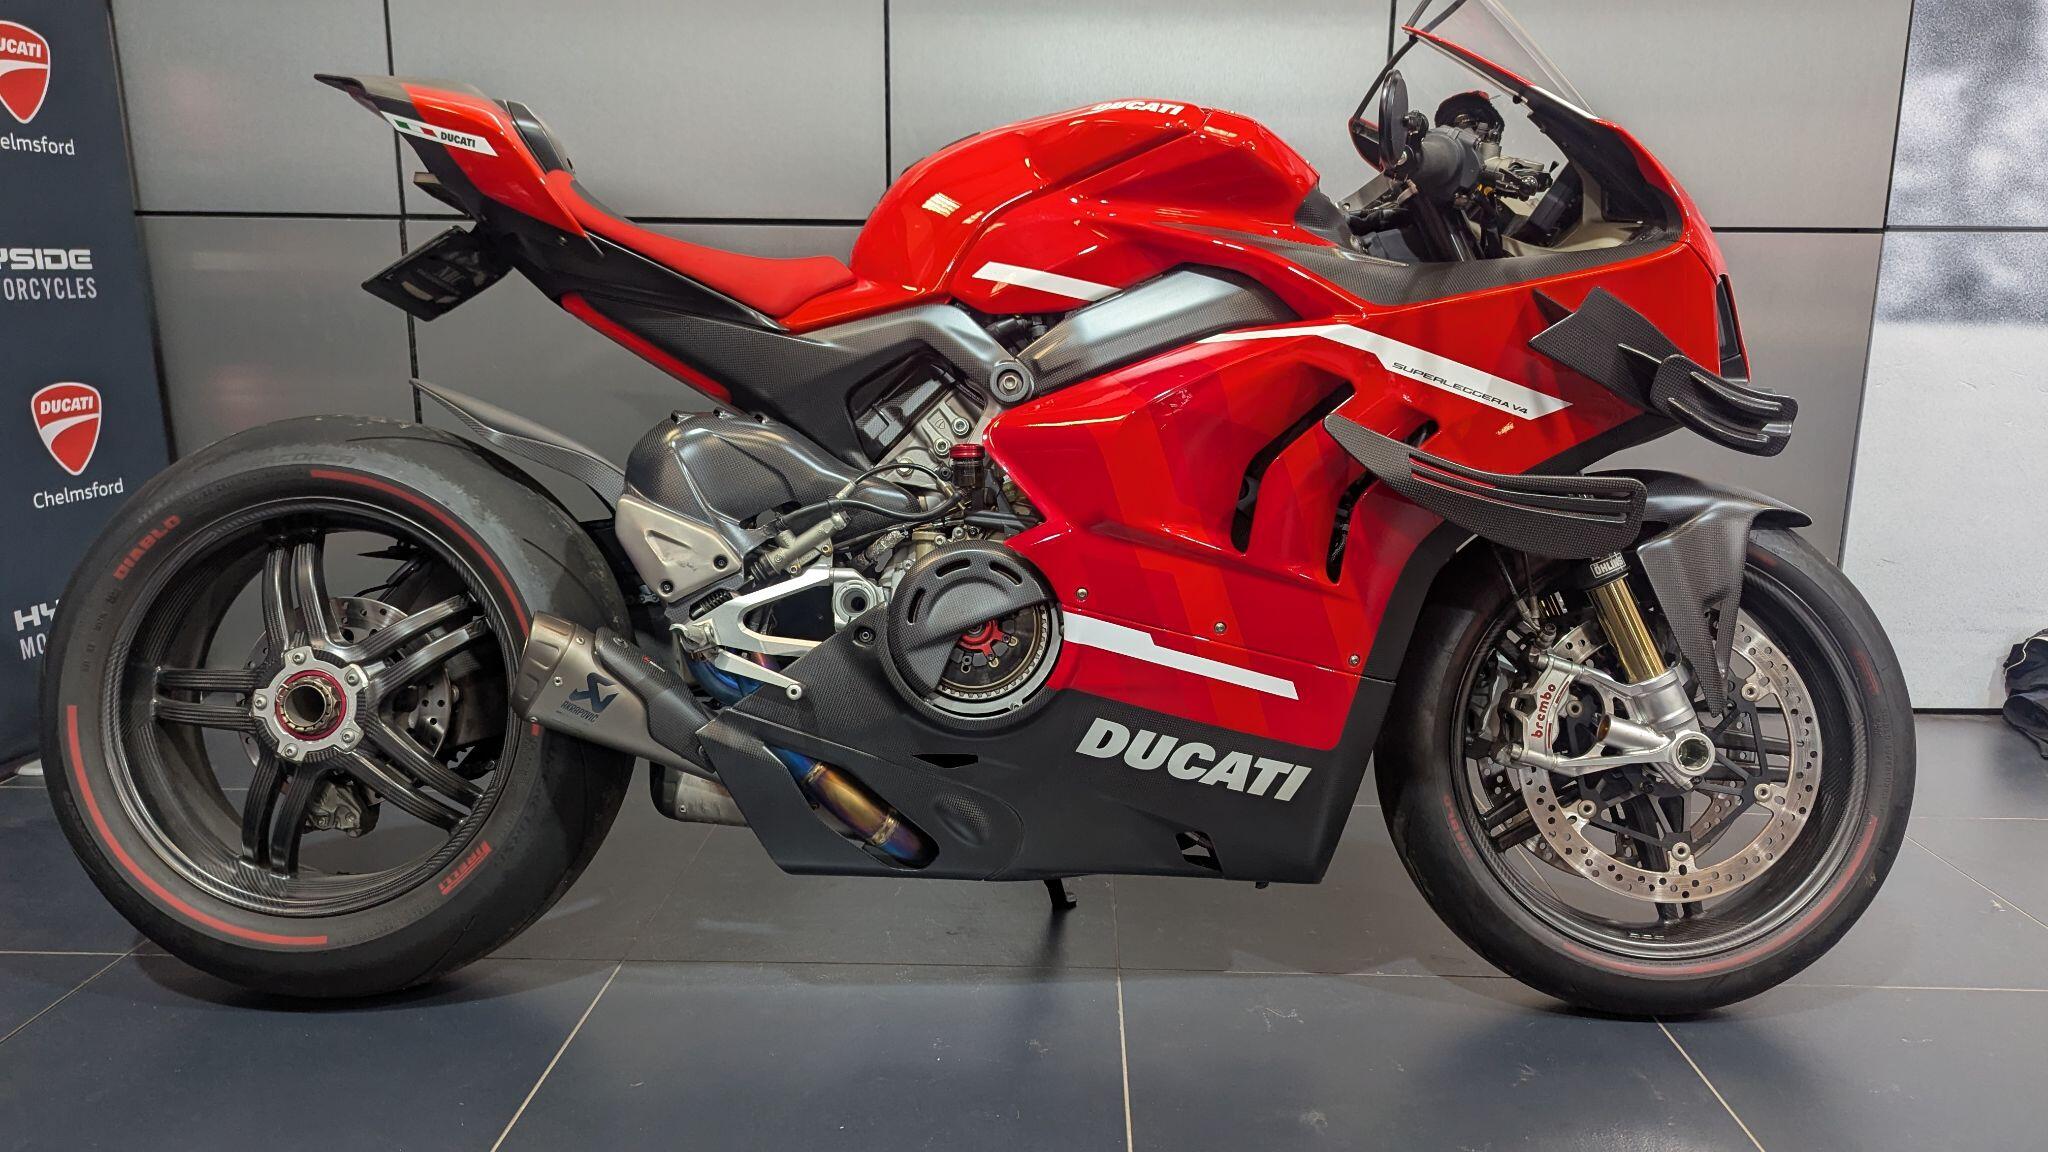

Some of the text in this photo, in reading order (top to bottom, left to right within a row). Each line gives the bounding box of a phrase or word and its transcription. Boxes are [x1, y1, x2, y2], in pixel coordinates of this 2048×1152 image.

[1091, 101, 1185, 115] DUCATI
[440, 131, 476, 148] DUCATI
[40, 396, 94, 415] DUCATI
[1392, 361, 1528, 414] SUPERLEGGERA V4
[33, 478, 124, 509] Chelmsford
[113, 514, 181, 580] DIABLO
[1531, 684, 1556, 738] brembo
[1075, 717, 1312, 802] DUCATI
